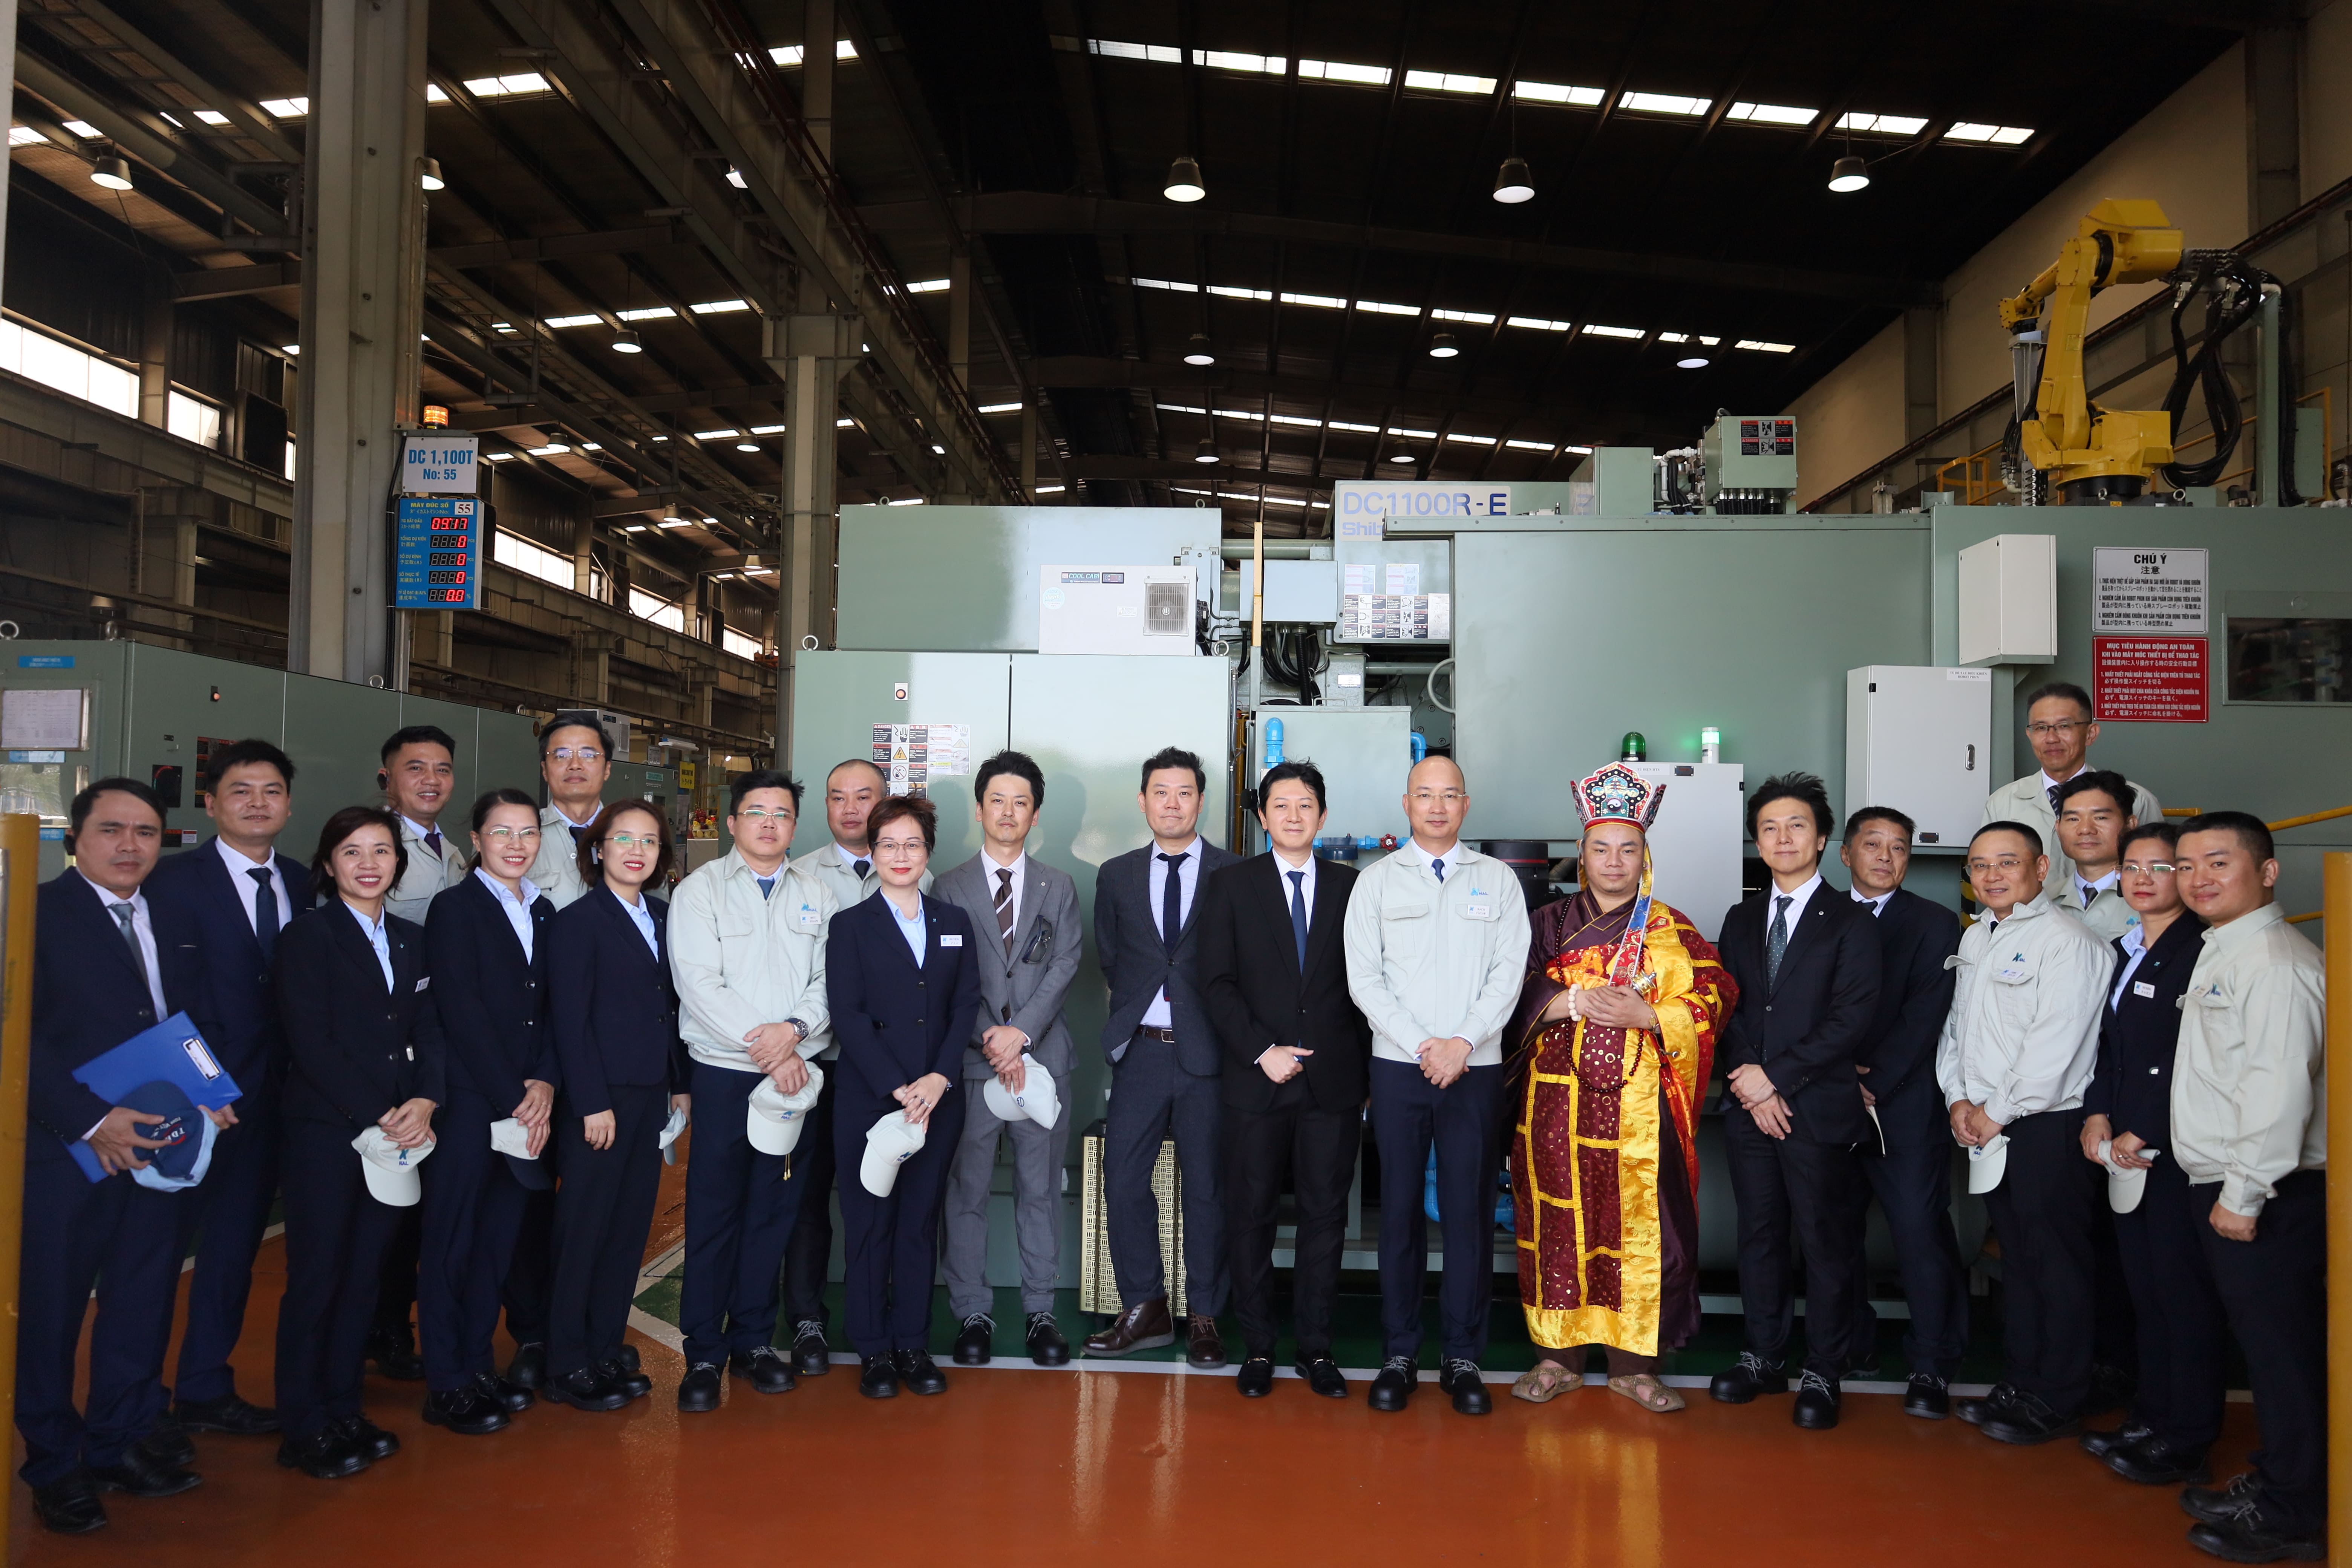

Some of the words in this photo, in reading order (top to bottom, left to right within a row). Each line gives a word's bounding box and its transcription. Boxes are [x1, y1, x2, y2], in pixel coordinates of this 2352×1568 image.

[409, 450, 426, 464] DC
[431, 450, 473, 466] 1,100T
[423, 469, 440, 480] No:
[444, 469, 456, 480] 55
[458, 504, 470, 513] 55
[2134, 553, 2156, 564] CHÚ
[2161, 553, 2167, 564] Ý
